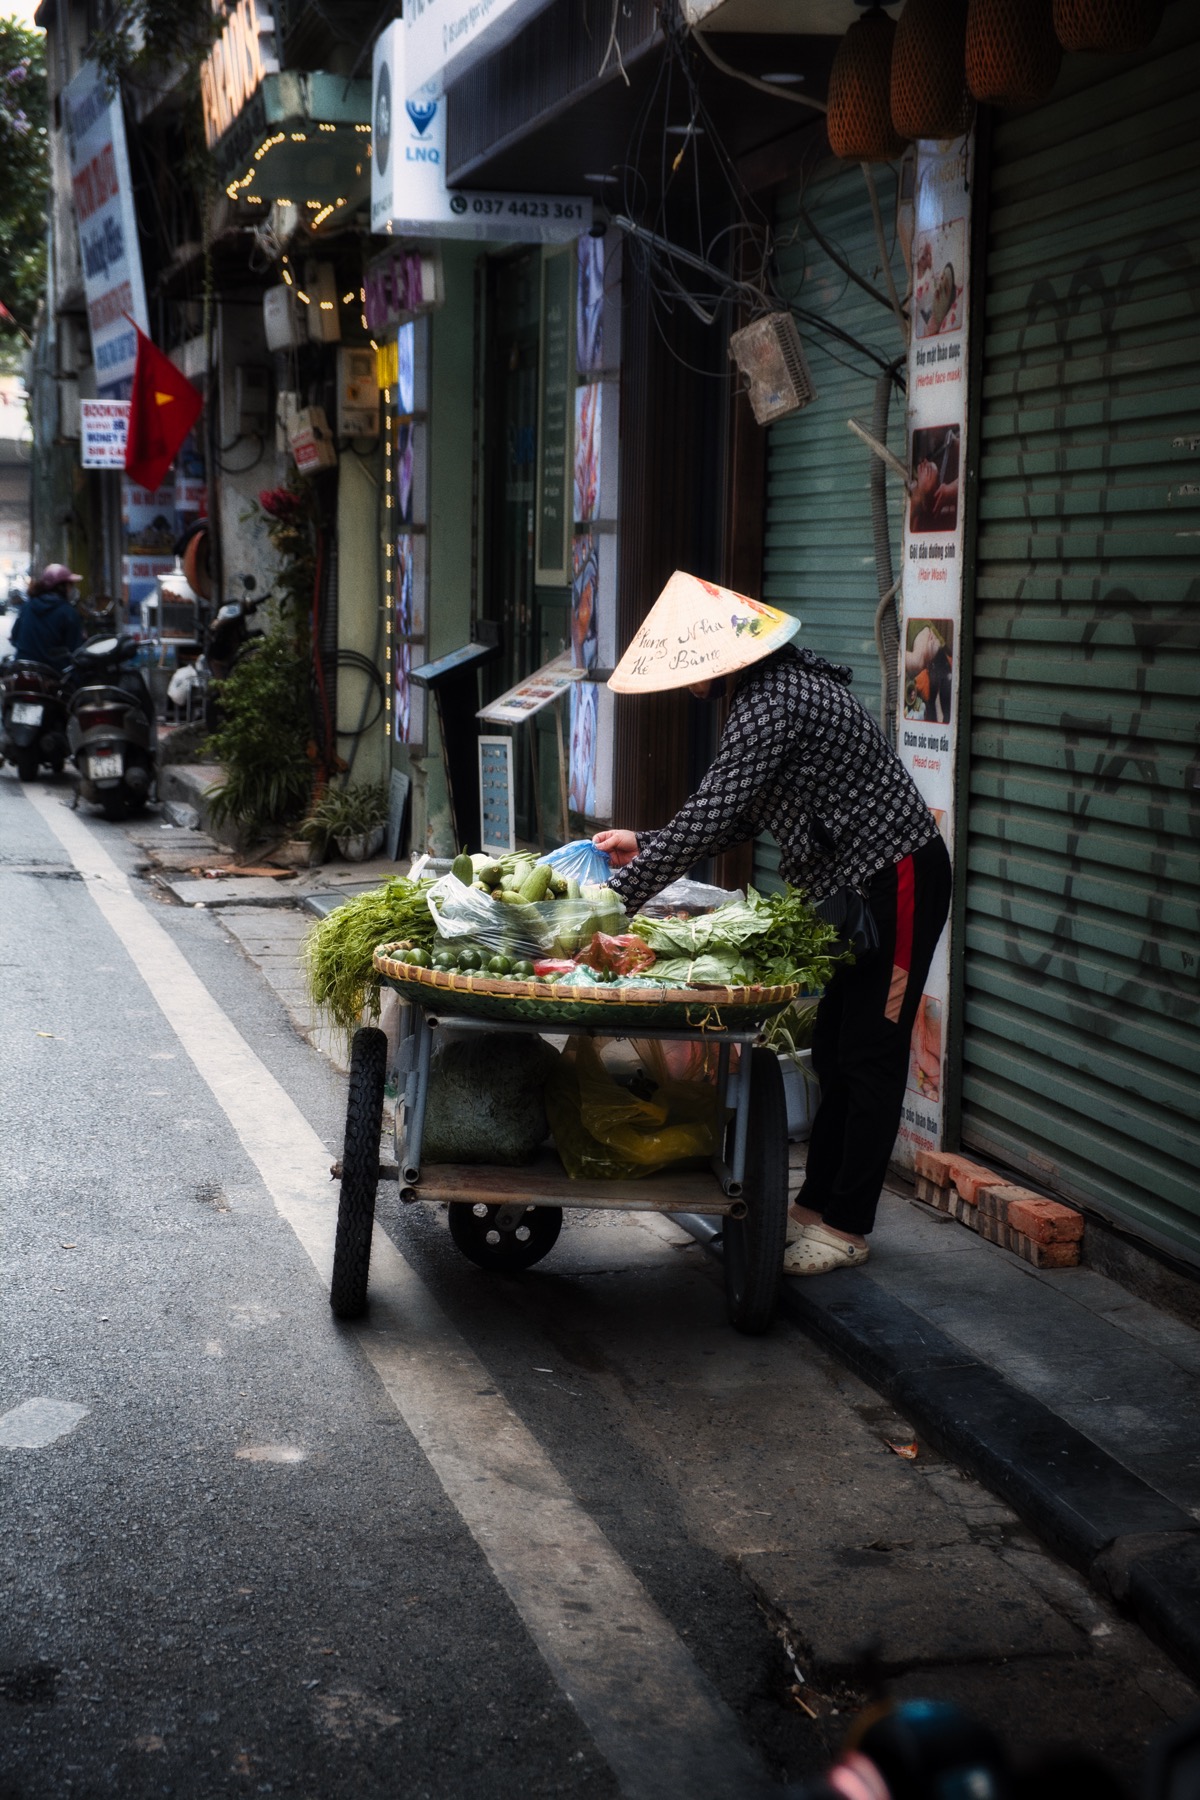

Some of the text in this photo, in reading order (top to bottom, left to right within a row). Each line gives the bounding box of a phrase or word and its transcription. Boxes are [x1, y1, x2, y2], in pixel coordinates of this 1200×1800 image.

[406, 148, 440, 164] LNQ
[473, 200, 583, 218] 037 4423 361
[935, 371, 945, 384] face
[87, 432, 118, 443] MONEY
[945, 542, 955, 558] sinh
[632, 618, 726, 660] Phong Nha
[918, 733, 926, 749] sóc
[912, 754, 941, 774] (Head care)
